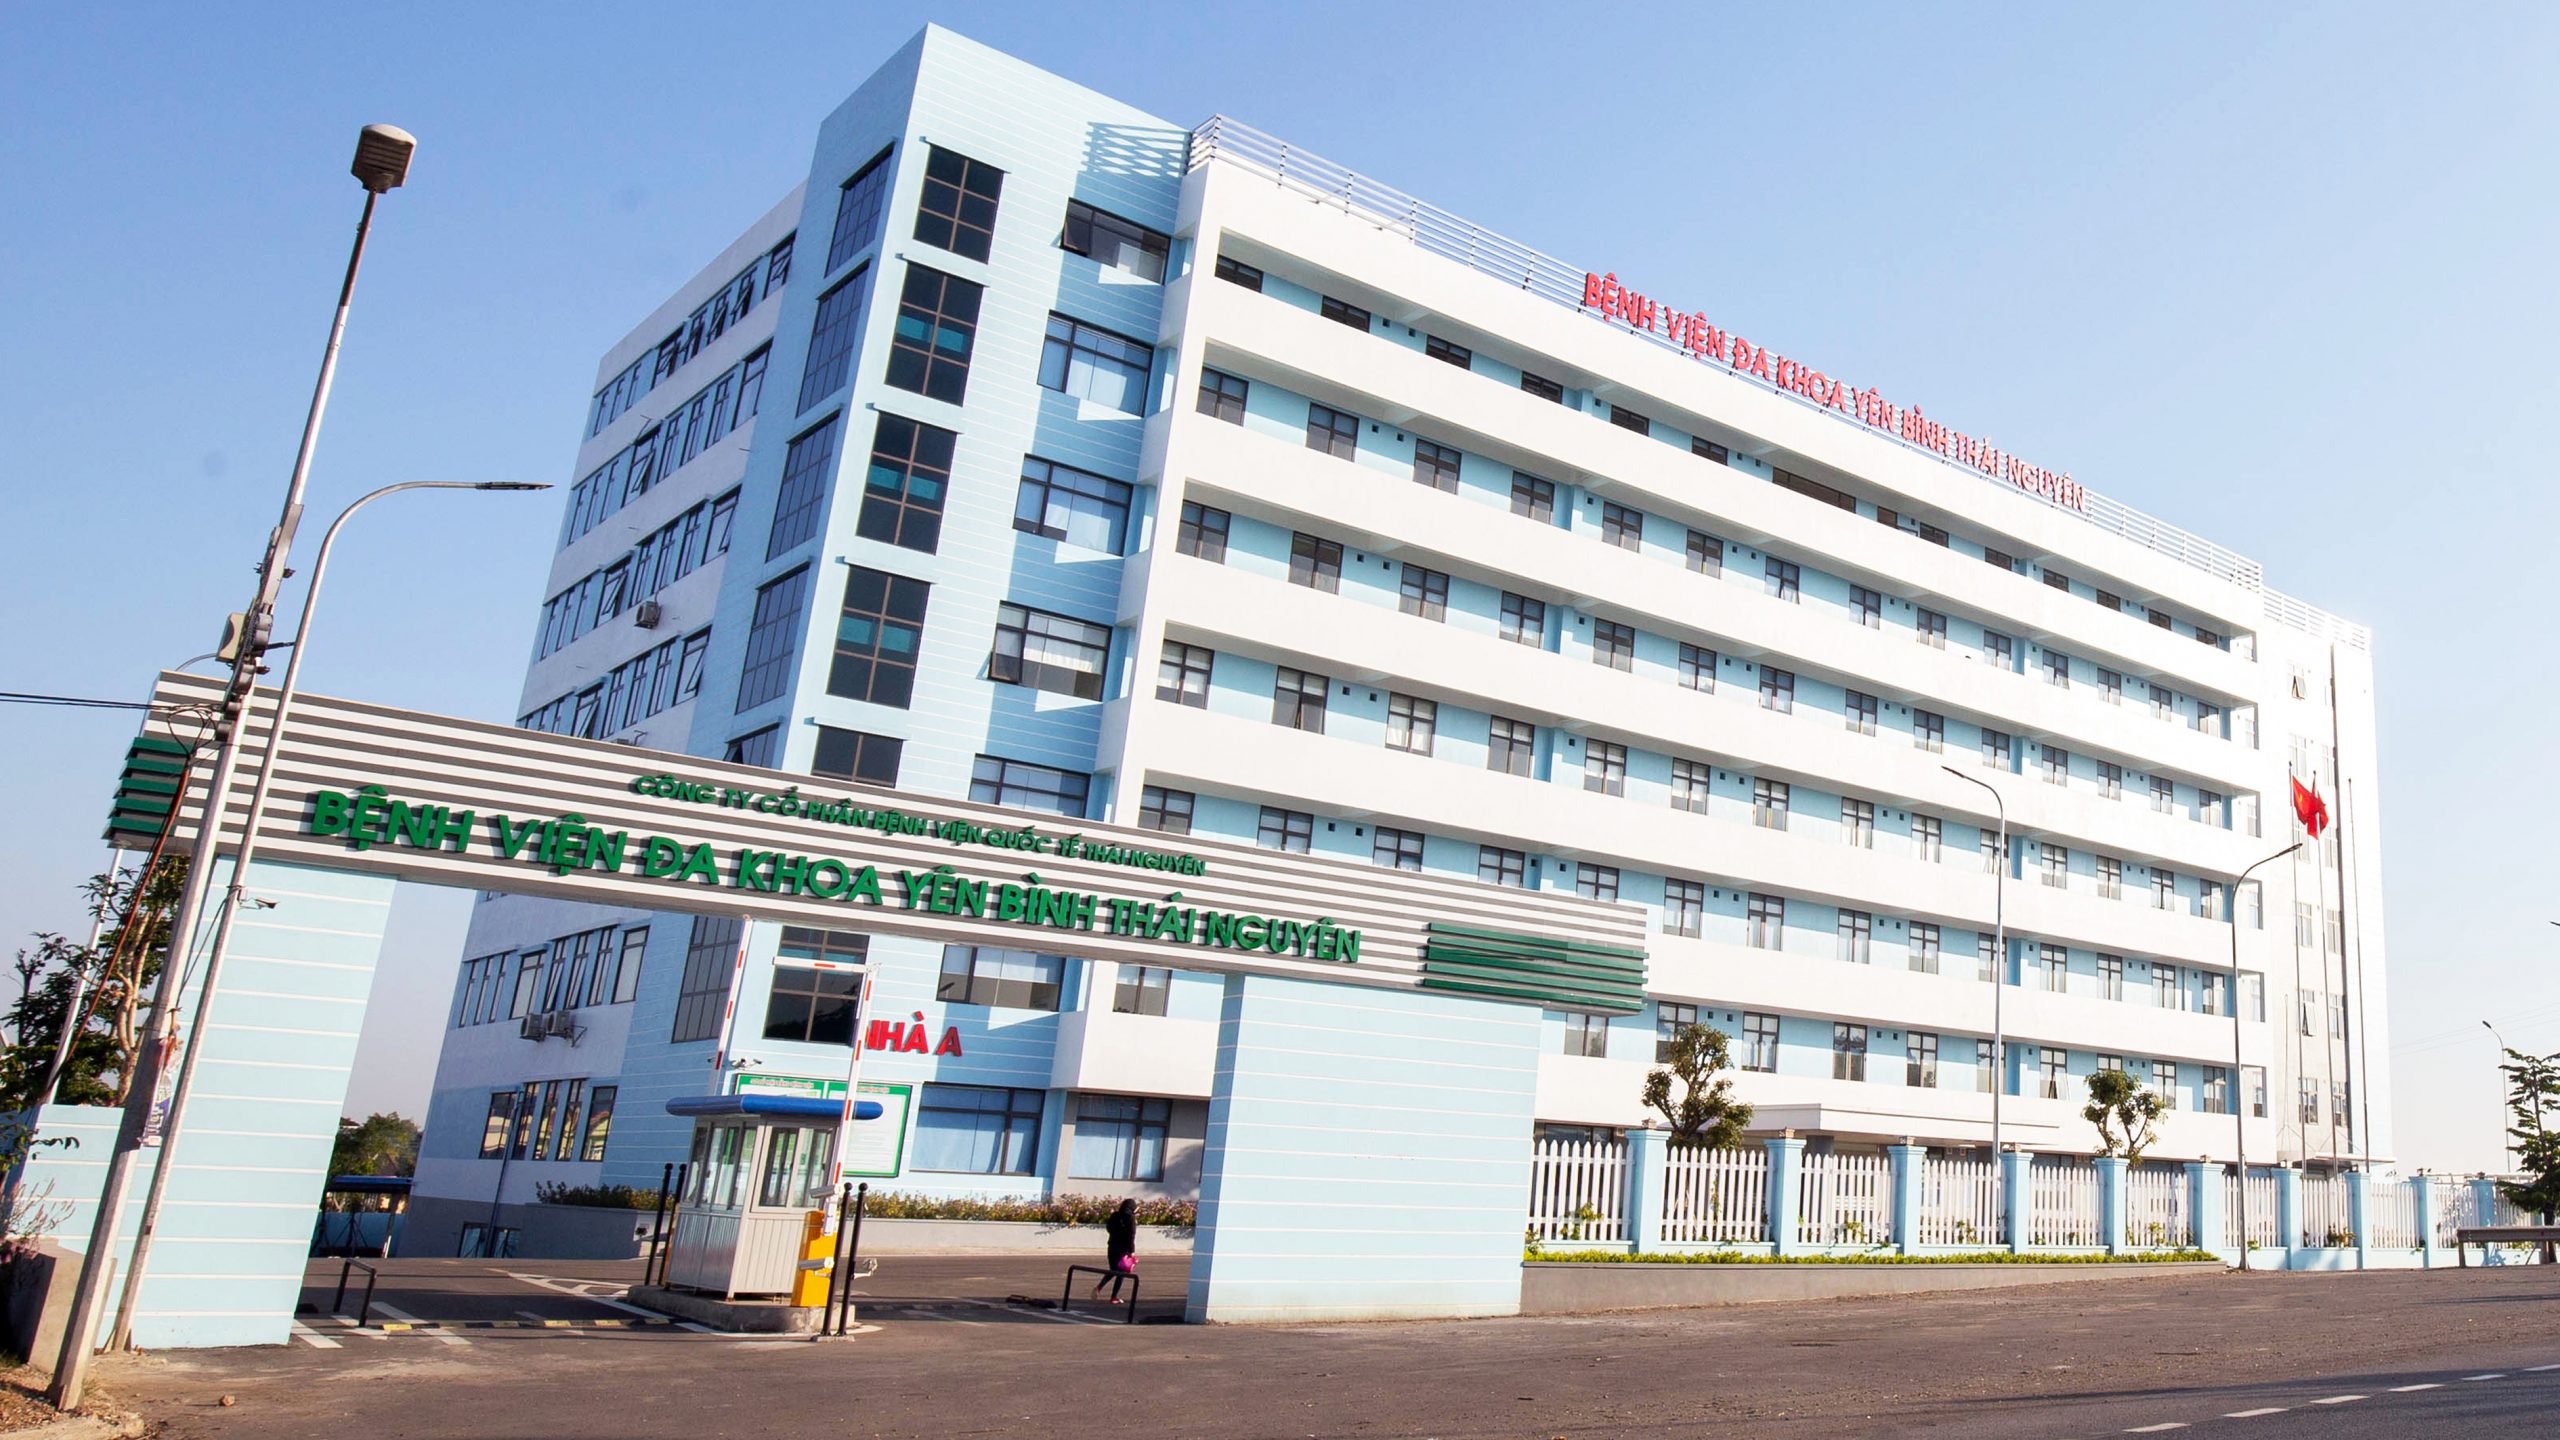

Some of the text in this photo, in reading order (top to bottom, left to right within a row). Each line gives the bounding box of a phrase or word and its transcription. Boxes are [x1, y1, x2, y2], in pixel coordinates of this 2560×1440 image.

[1584, 272, 2085, 512] BỆNH VIỆN ĐA KHOA YÊN BÌNH THÁI NGUYÊN
[311, 784, 1361, 963] BỆNH VIỆN ĐA KHOA YÊN BÌNH THÁI NGUYÊN
[636, 773, 716, 803] CÔNG
[724, 787, 754, 809] TY
[873, 808, 927, 836] BỆNH
[936, 819, 983, 846] VIỆN
[988, 825, 1052, 854] QUỐC
[1084, 843, 1127, 865] THÁI
[1130, 853, 1206, 876] NGUYÊN
[934, 1026, 963, 1057] A
